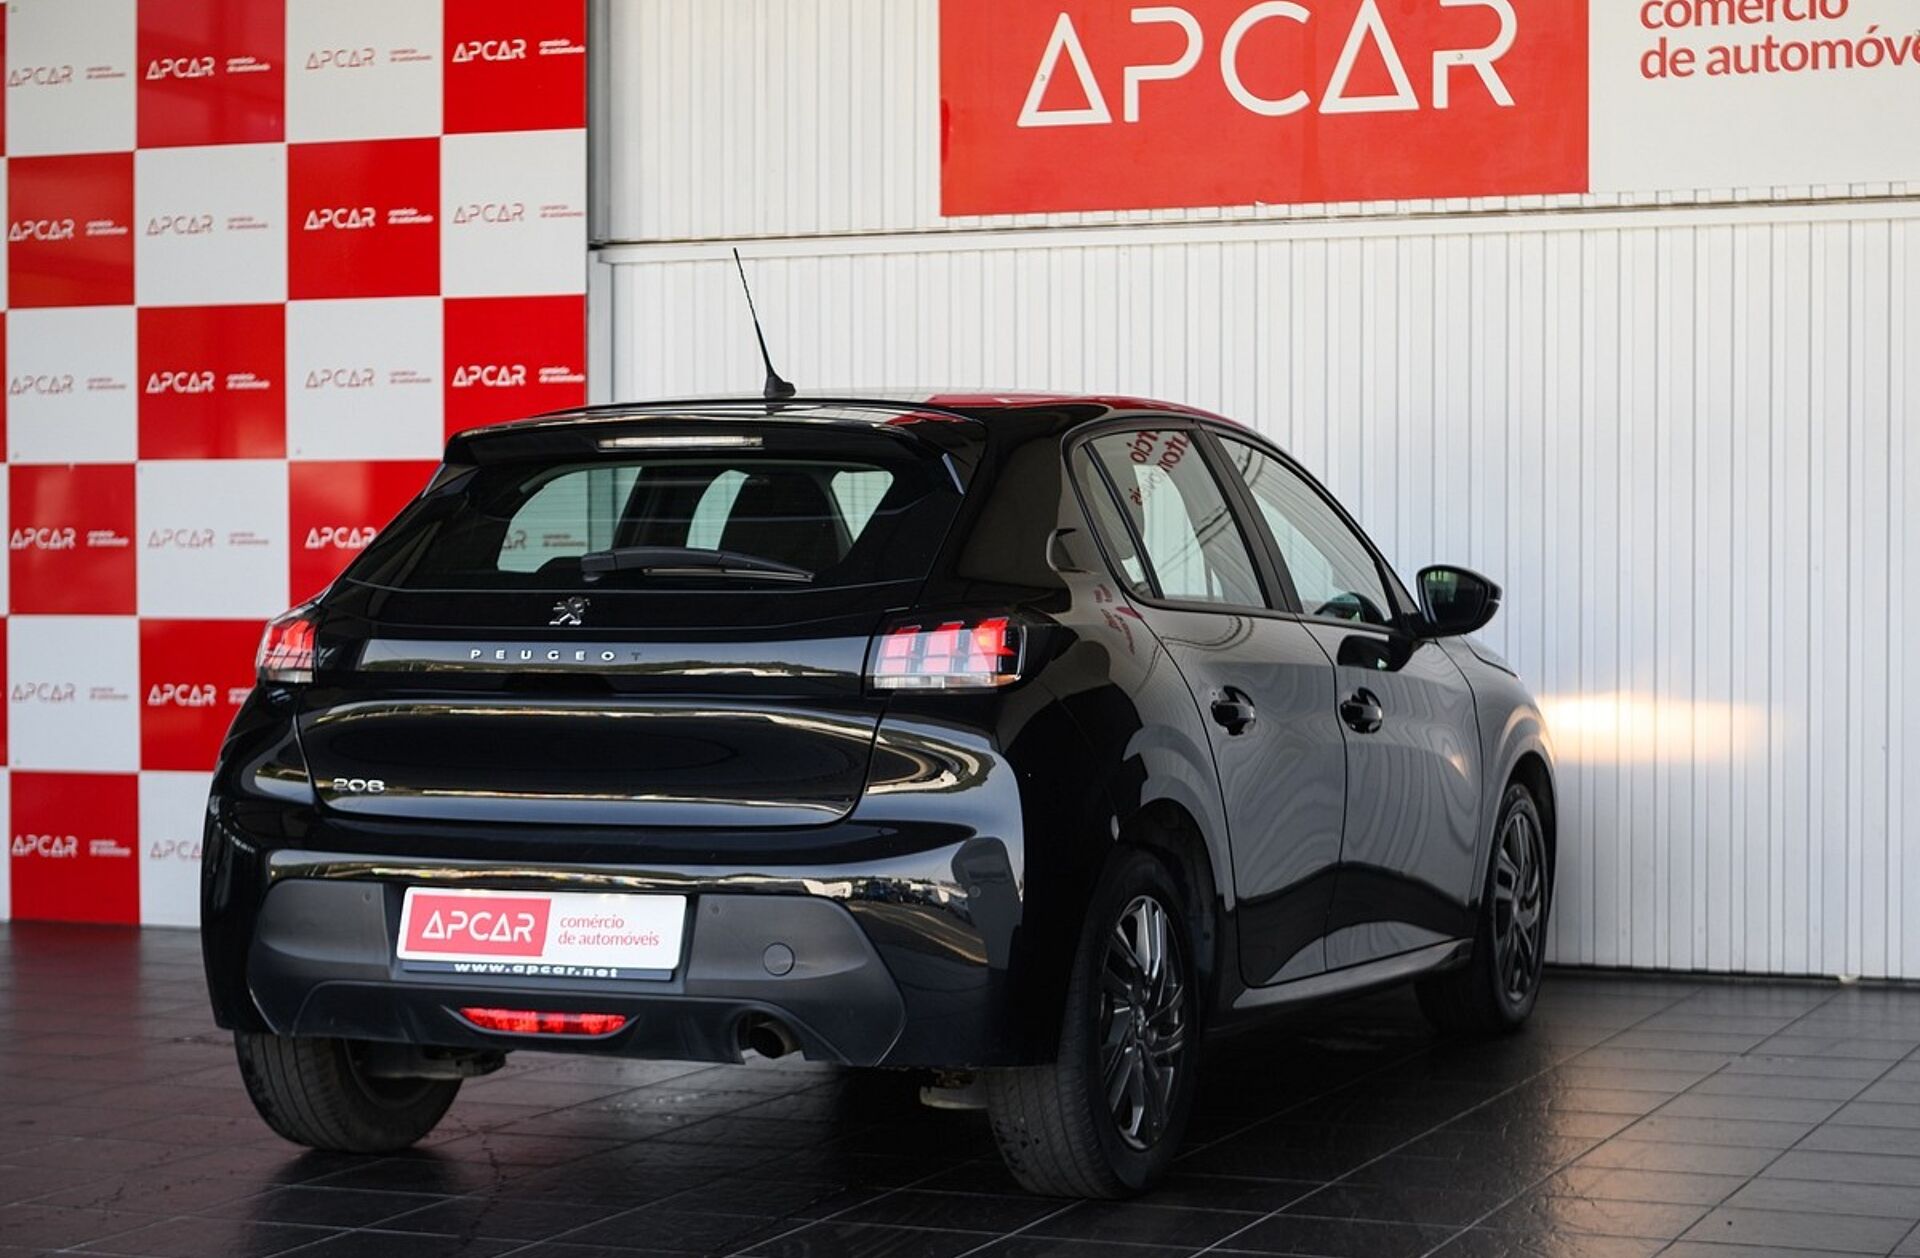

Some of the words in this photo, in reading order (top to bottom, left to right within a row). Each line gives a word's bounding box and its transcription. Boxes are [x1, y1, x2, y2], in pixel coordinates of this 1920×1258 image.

[305, 48, 374, 70] APCAR
[452, 39, 526, 62] APCAR
[1640, 37, 1695, 79] de
[146, 57, 215, 80] APCAR
[1016, 0, 1518, 128] APCAR
[8, 65, 73, 87] APCAR
[304, 207, 375, 230] APCAR
[453, 203, 524, 224] APCAR
[9, 219, 75, 241] APCAR
[146, 215, 213, 236] APCAR
[9, 375, 73, 395] APCAR
[146, 371, 215, 393] APCAR
[305, 368, 374, 389] APCAR
[452, 365, 526, 387] APCAR
[9, 527, 75, 549] APCAR
[147, 529, 215, 549] APCAR
[470, 648, 643, 662] PEUGEOT
[11, 683, 75, 702] APCAR
[148, 684, 216, 706] APCAR
[332, 777, 385, 793] 208
[11, 834, 78, 857] APCAR
[421, 909, 536, 943] APCAR
[559, 913, 625, 929] comércio
[557, 929, 576, 945] de
[578, 929, 660, 947] automóveis
[454, 961, 619, 978] www.apcar.net
